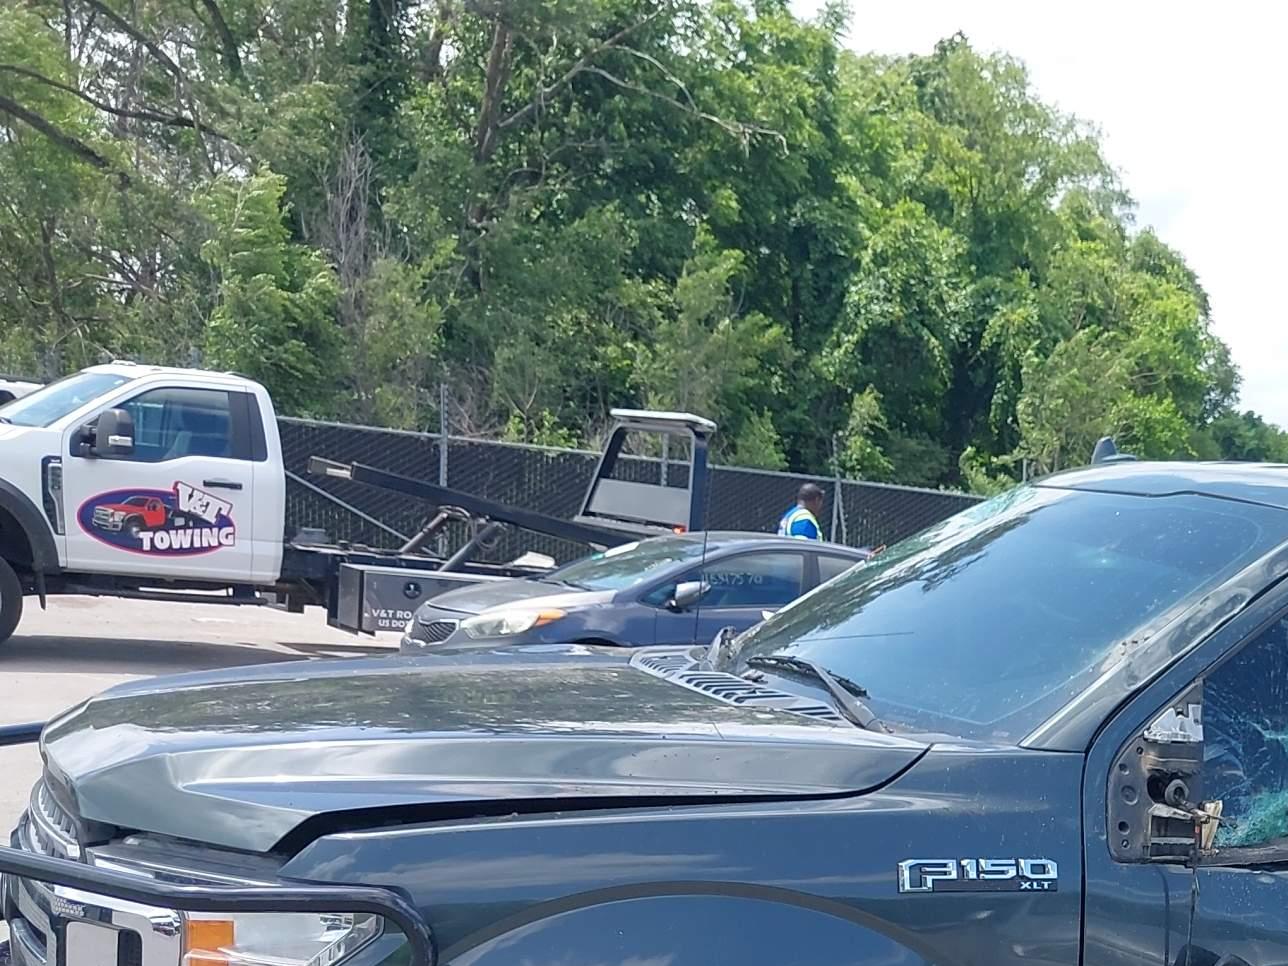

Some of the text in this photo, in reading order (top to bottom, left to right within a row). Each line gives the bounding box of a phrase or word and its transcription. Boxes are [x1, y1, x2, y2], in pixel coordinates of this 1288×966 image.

[176, 482, 232, 525] V&T
[138, 527, 236, 551] TOWING
[371, 608, 394, 618] V&T
[378, 618, 390, 627] US
[1020, 881, 1053, 890] XLT
